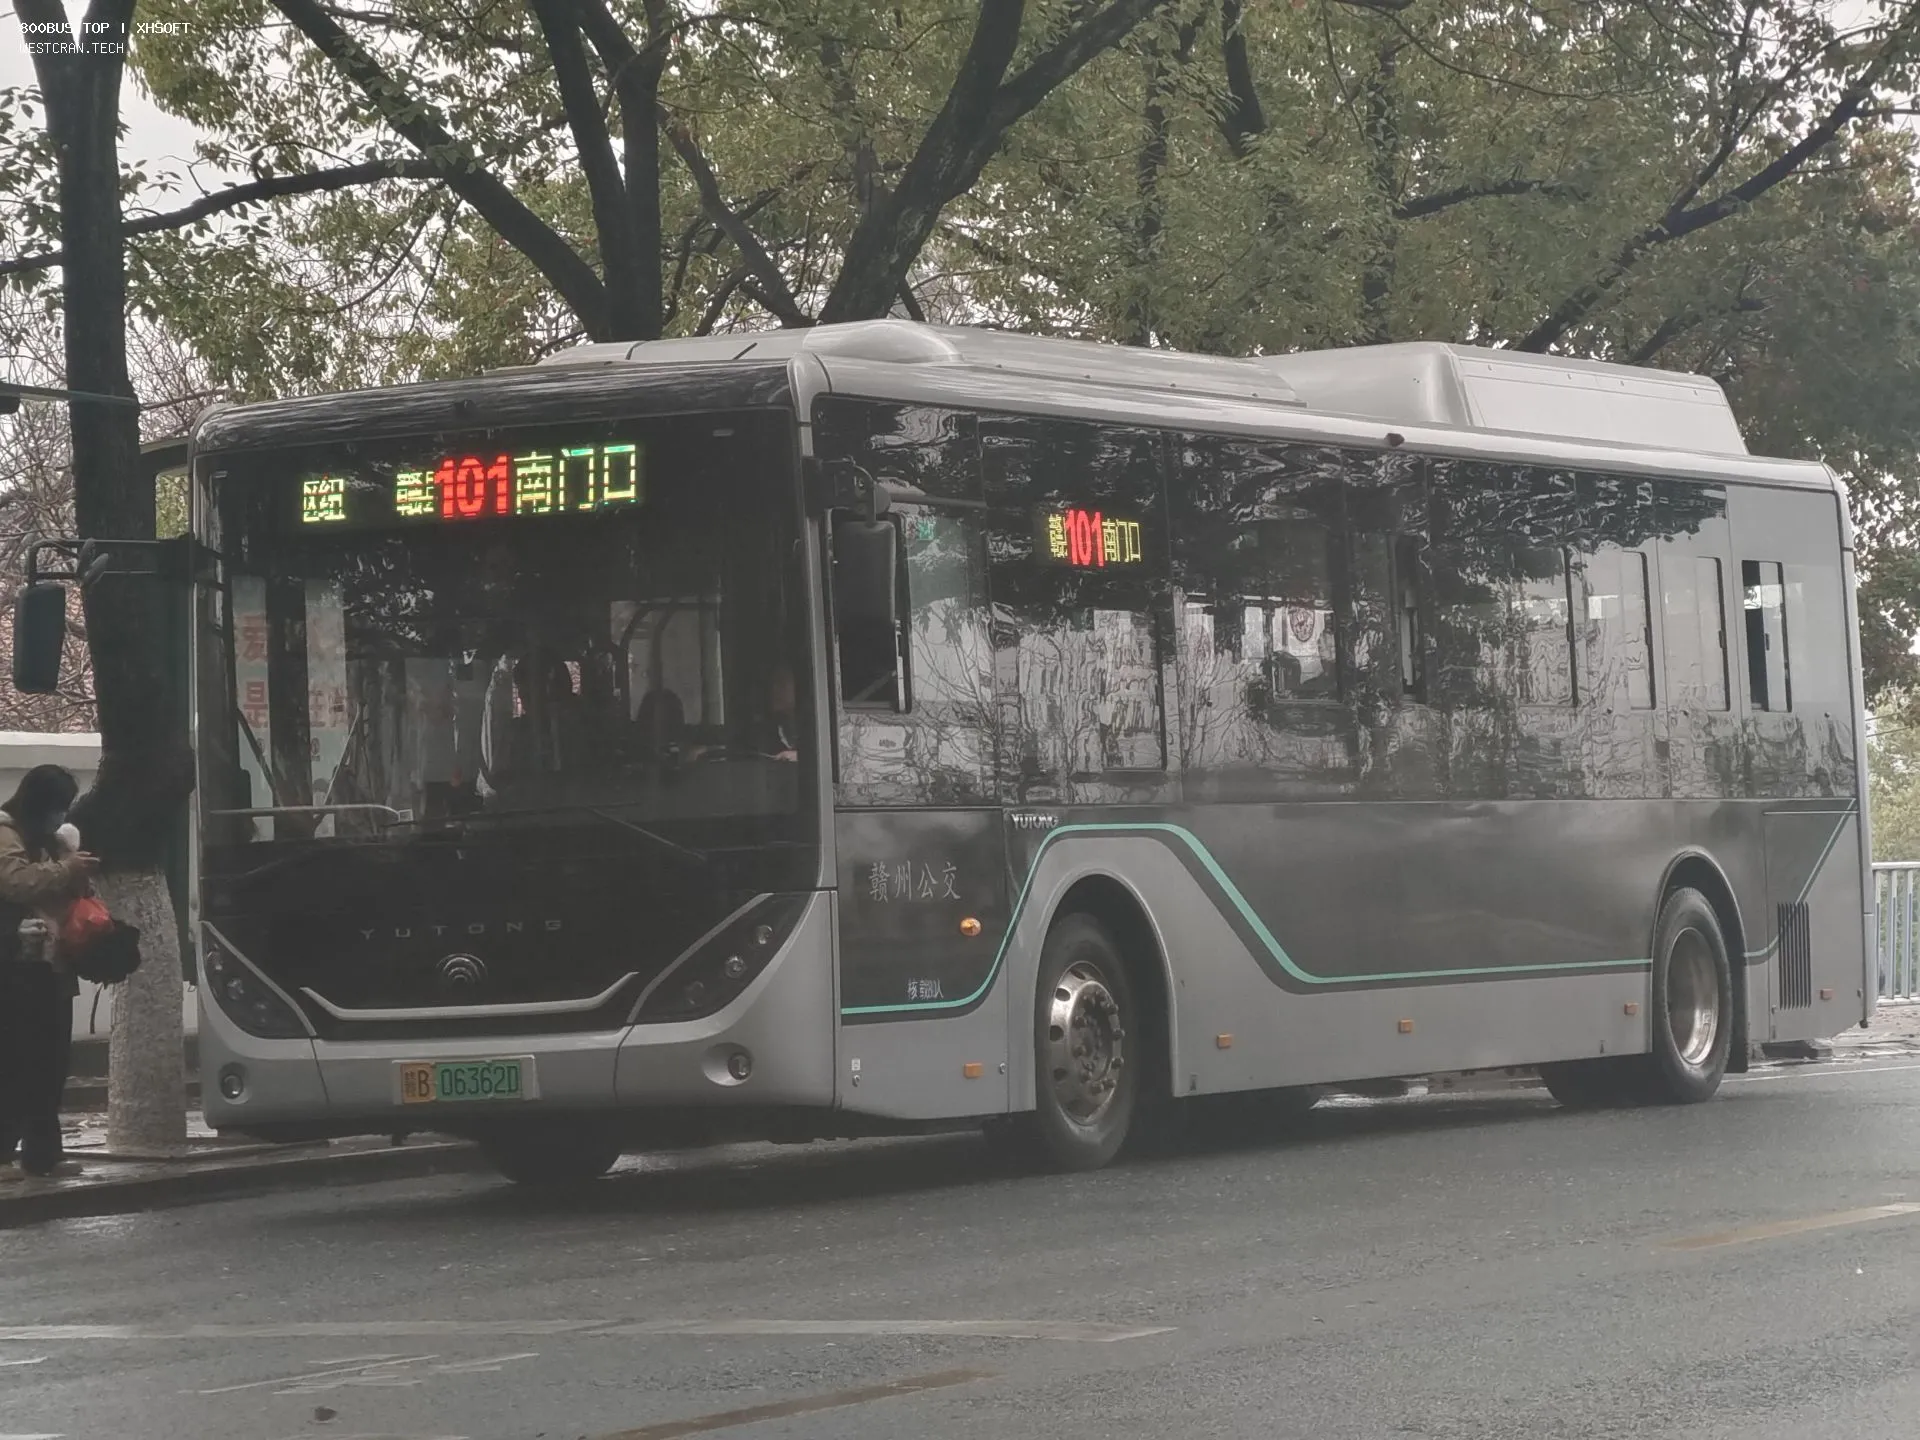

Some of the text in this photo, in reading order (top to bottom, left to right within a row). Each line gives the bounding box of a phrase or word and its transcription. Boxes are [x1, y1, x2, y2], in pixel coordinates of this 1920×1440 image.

[434, 455, 509, 518] 101
[1065, 509, 1104, 567] 101
[1010, 813, 1059, 831] YUTONG
[868, 859, 961, 904] 赣州公交
[359, 919, 562, 941] YUTONG
[440, 1065, 519, 1096] 06362D
